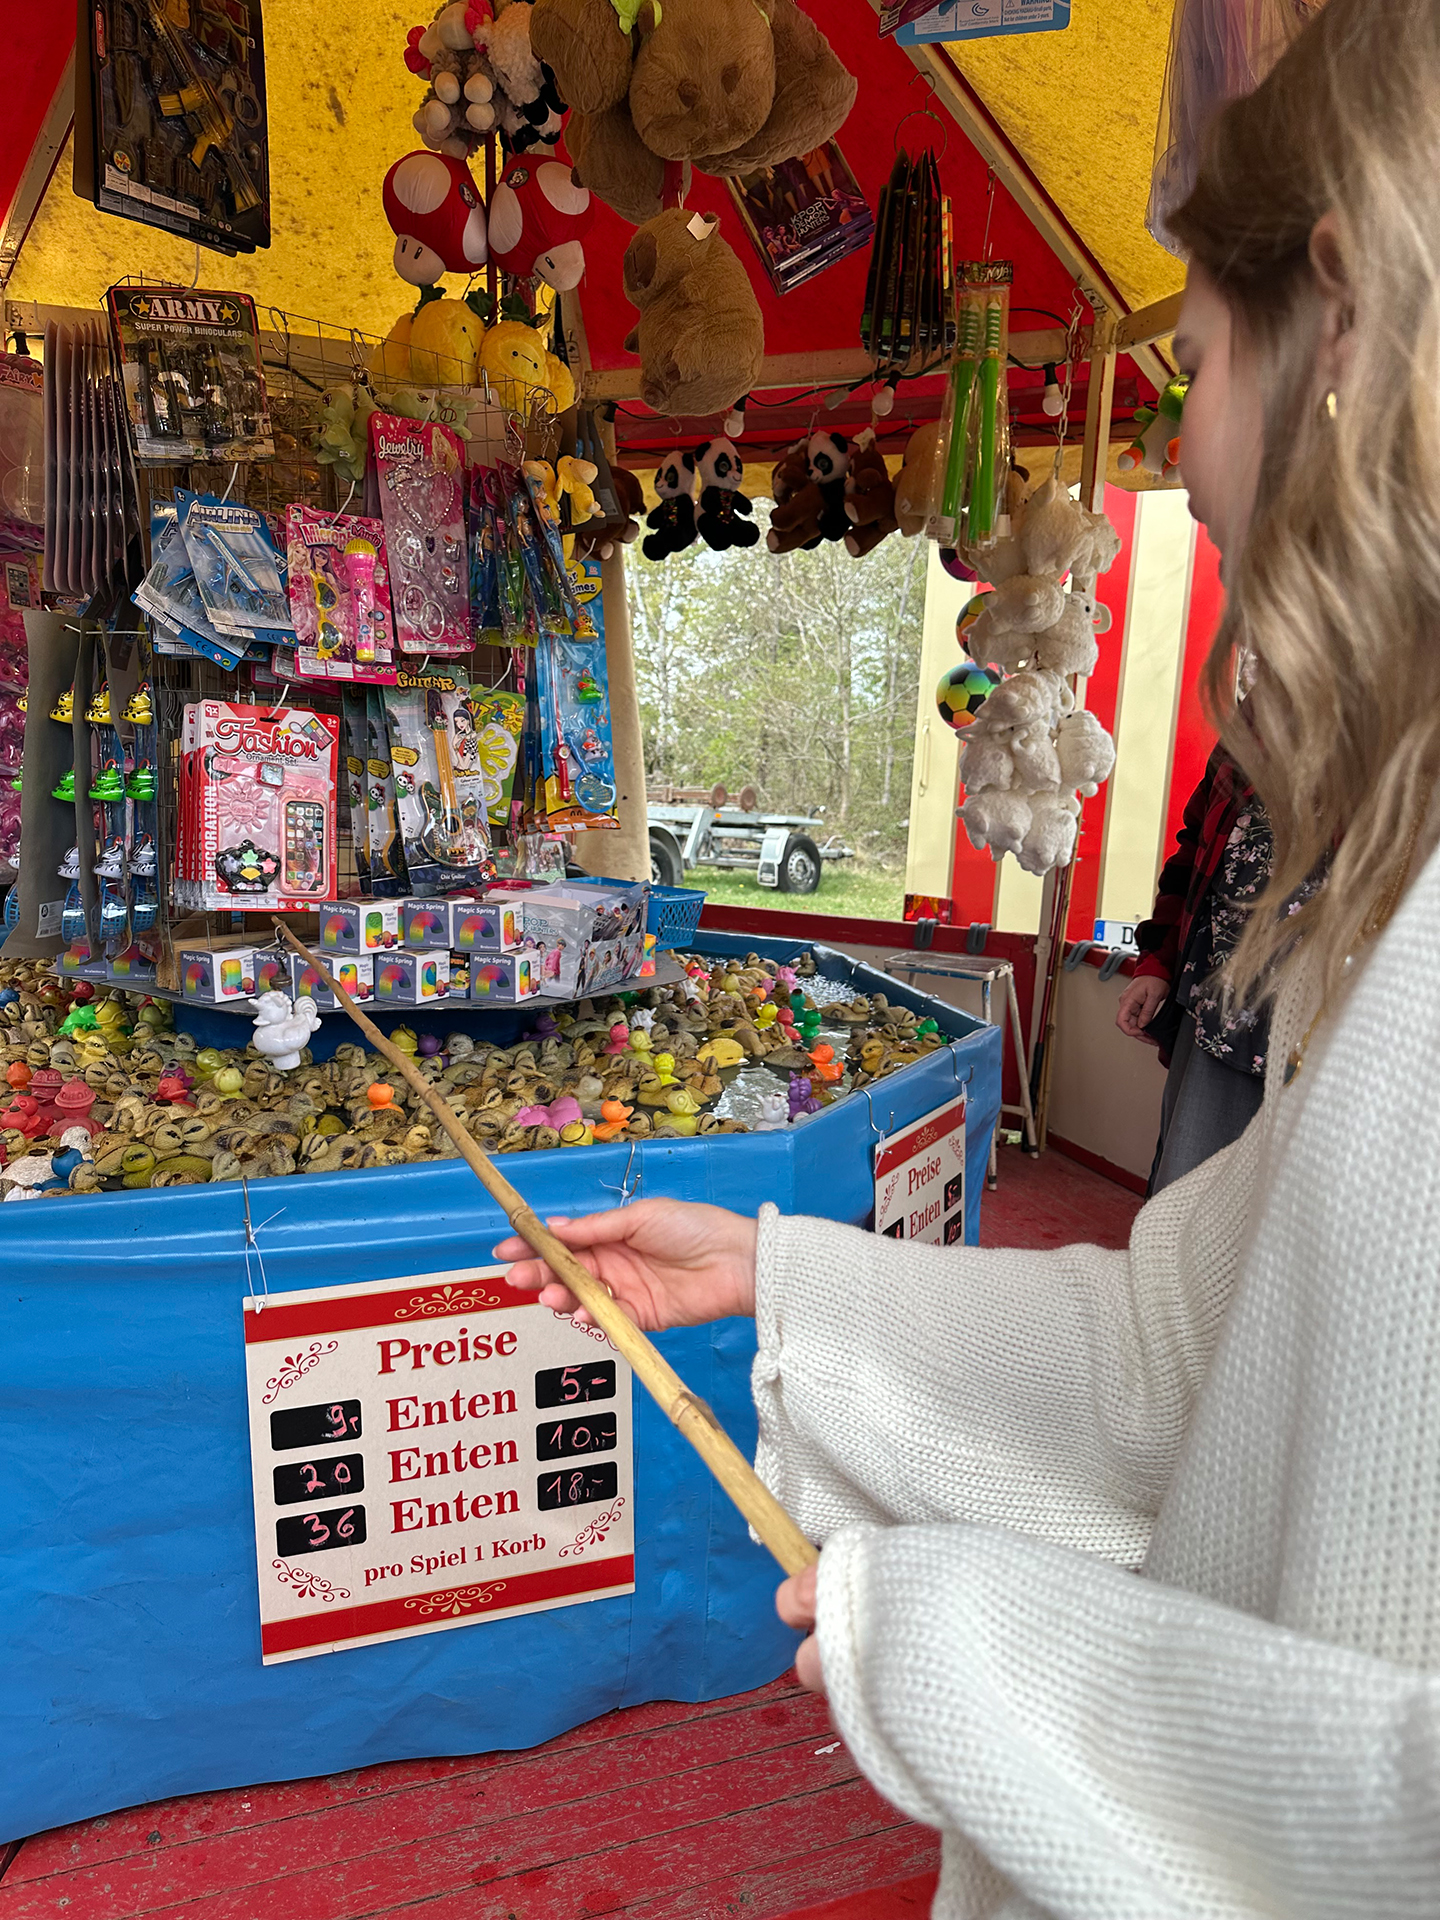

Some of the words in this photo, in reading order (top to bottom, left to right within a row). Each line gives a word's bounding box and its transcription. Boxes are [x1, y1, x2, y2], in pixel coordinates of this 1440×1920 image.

[149, 298, 221, 322] ARMY
[135, 322, 162, 332] SUPER
[164, 323, 193, 335] POWER
[194, 326, 243, 338] BINOCULARS
[378, 434, 425, 461] Jewelry
[215, 716, 319, 759] Fashion
[204, 785, 218, 881] DECORATION
[323, 905, 338, 913] Magic
[339, 906, 357, 916] Spring
[407, 902, 425, 910] Magic
[426, 903, 445, 912] Spring
[457, 906, 476, 914] Magic
[476, 907, 496, 916] Spring
[182, 953, 196, 961] Magic
[196, 954, 211, 964] Spring
[256, 953, 271, 961] Magic
[378, 955, 393, 963] Magic
[394, 956, 413, 966] Spring
[491, 957, 511, 965] Spring
[908, 1156, 941, 1197] Preise
[909, 1199, 941, 1240] Enten
[376, 1327, 518, 1376] Preise
[385, 1389, 519, 1433] Enten
[300, 1462, 352, 1494] 20
[387, 1440, 519, 1484] Enten
[303, 1509, 355, 1546] 36
[390, 1490, 521, 1534] Enten
[364, 1562, 404, 1587] pro
[410, 1547, 467, 1576] Spiel
[474, 1545, 485, 1562] 1
[491, 1533, 547, 1559] Korb
